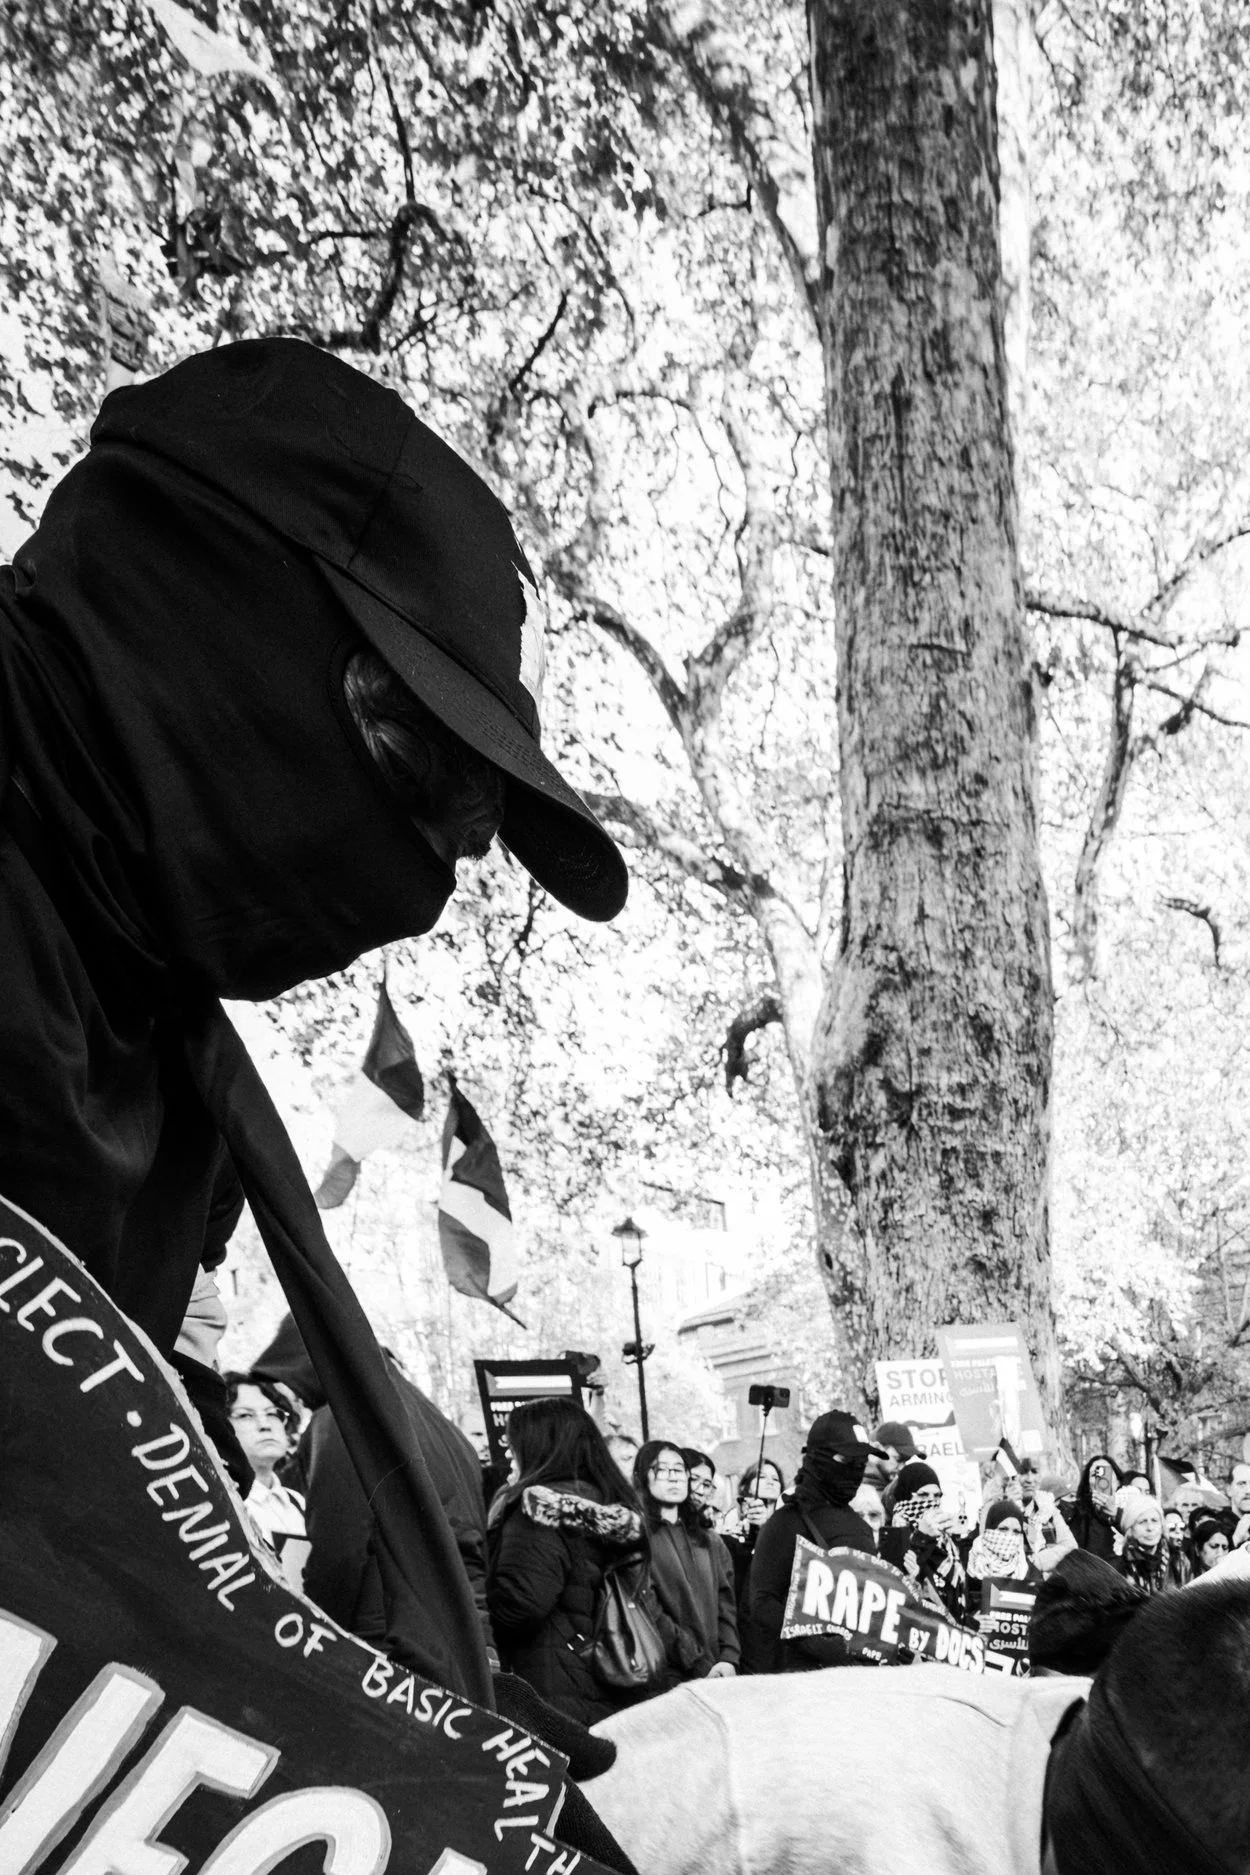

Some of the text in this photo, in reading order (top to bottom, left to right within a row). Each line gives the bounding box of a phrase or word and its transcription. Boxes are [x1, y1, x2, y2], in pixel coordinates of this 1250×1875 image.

[131, 1423, 256, 1611] DENIAL
[274, 1612, 337, 1657] OF
[361, 1656, 472, 1740] BASIC
[801, 1559, 906, 1645] RAPE
[908, 1626, 931, 1652] BY
